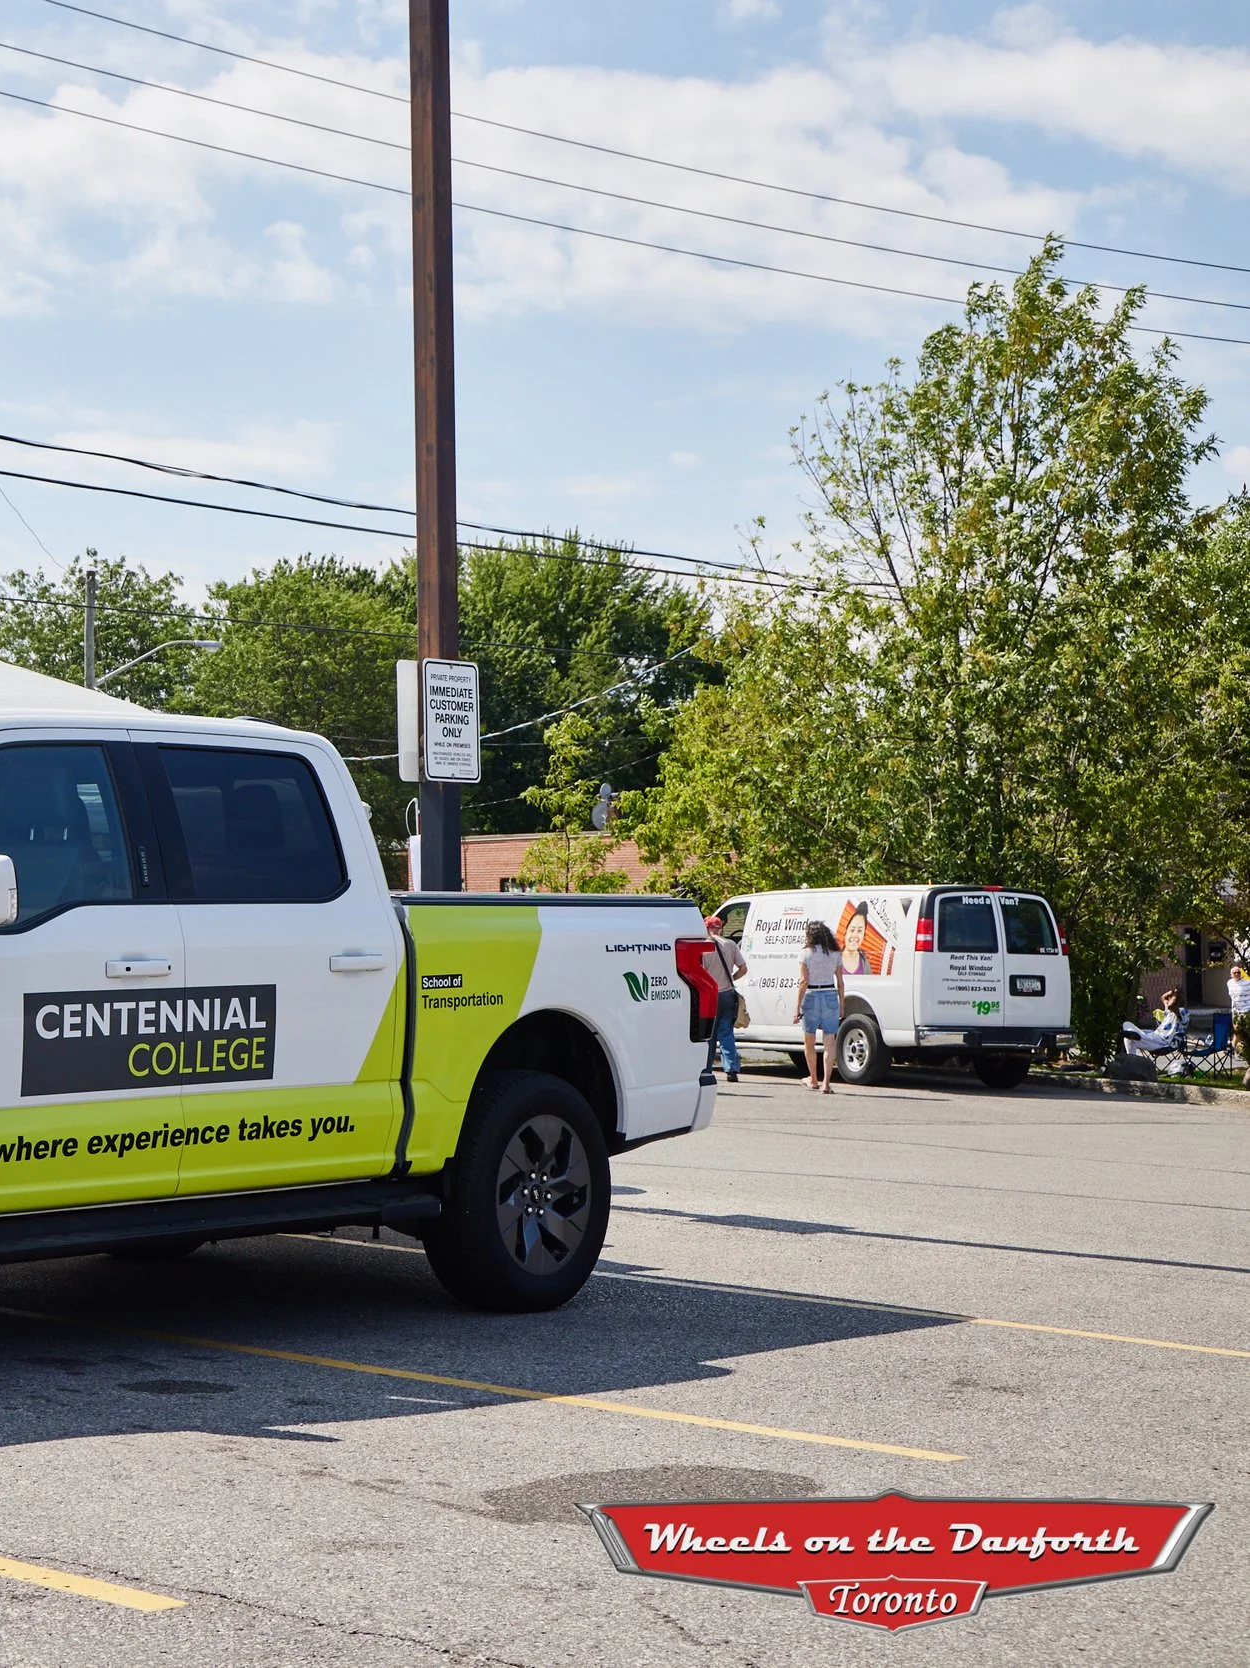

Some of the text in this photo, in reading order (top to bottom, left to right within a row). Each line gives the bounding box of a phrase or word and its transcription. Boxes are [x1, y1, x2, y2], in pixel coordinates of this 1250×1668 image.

[431, 673, 471, 683] PRIVATE PROPERTY
[430, 685, 473, 699] IMMEDIATE
[430, 699, 474, 712] CUSTOMER
[435, 713, 469, 725] PARKING
[442, 727, 462, 738] ONLY
[962, 896, 985, 905] Need
[999, 896, 1019, 906] Van?
[755, 918, 809, 933] Royal Wind
[764, 935, 806, 945] SELF-STORAG
[605, 944, 671, 954] LIGHTNING
[950, 965, 967, 973] Royal
[422, 975, 462, 988] School of
[650, 976, 668, 986] ZERO
[758, 976, 778, 989] (905)
[779, 978, 800, 989] 823-
[651, 989, 681, 1000] EMISSION
[422, 992, 503, 1011] Transportation
[35, 996, 267, 1040] CENTENNIAL
[128, 1036, 266, 1077] COLLEGE
[87, 1121, 230, 1158] experience
[238, 1115, 303, 1141] takes
[308, 1115, 356, 1143] you.
